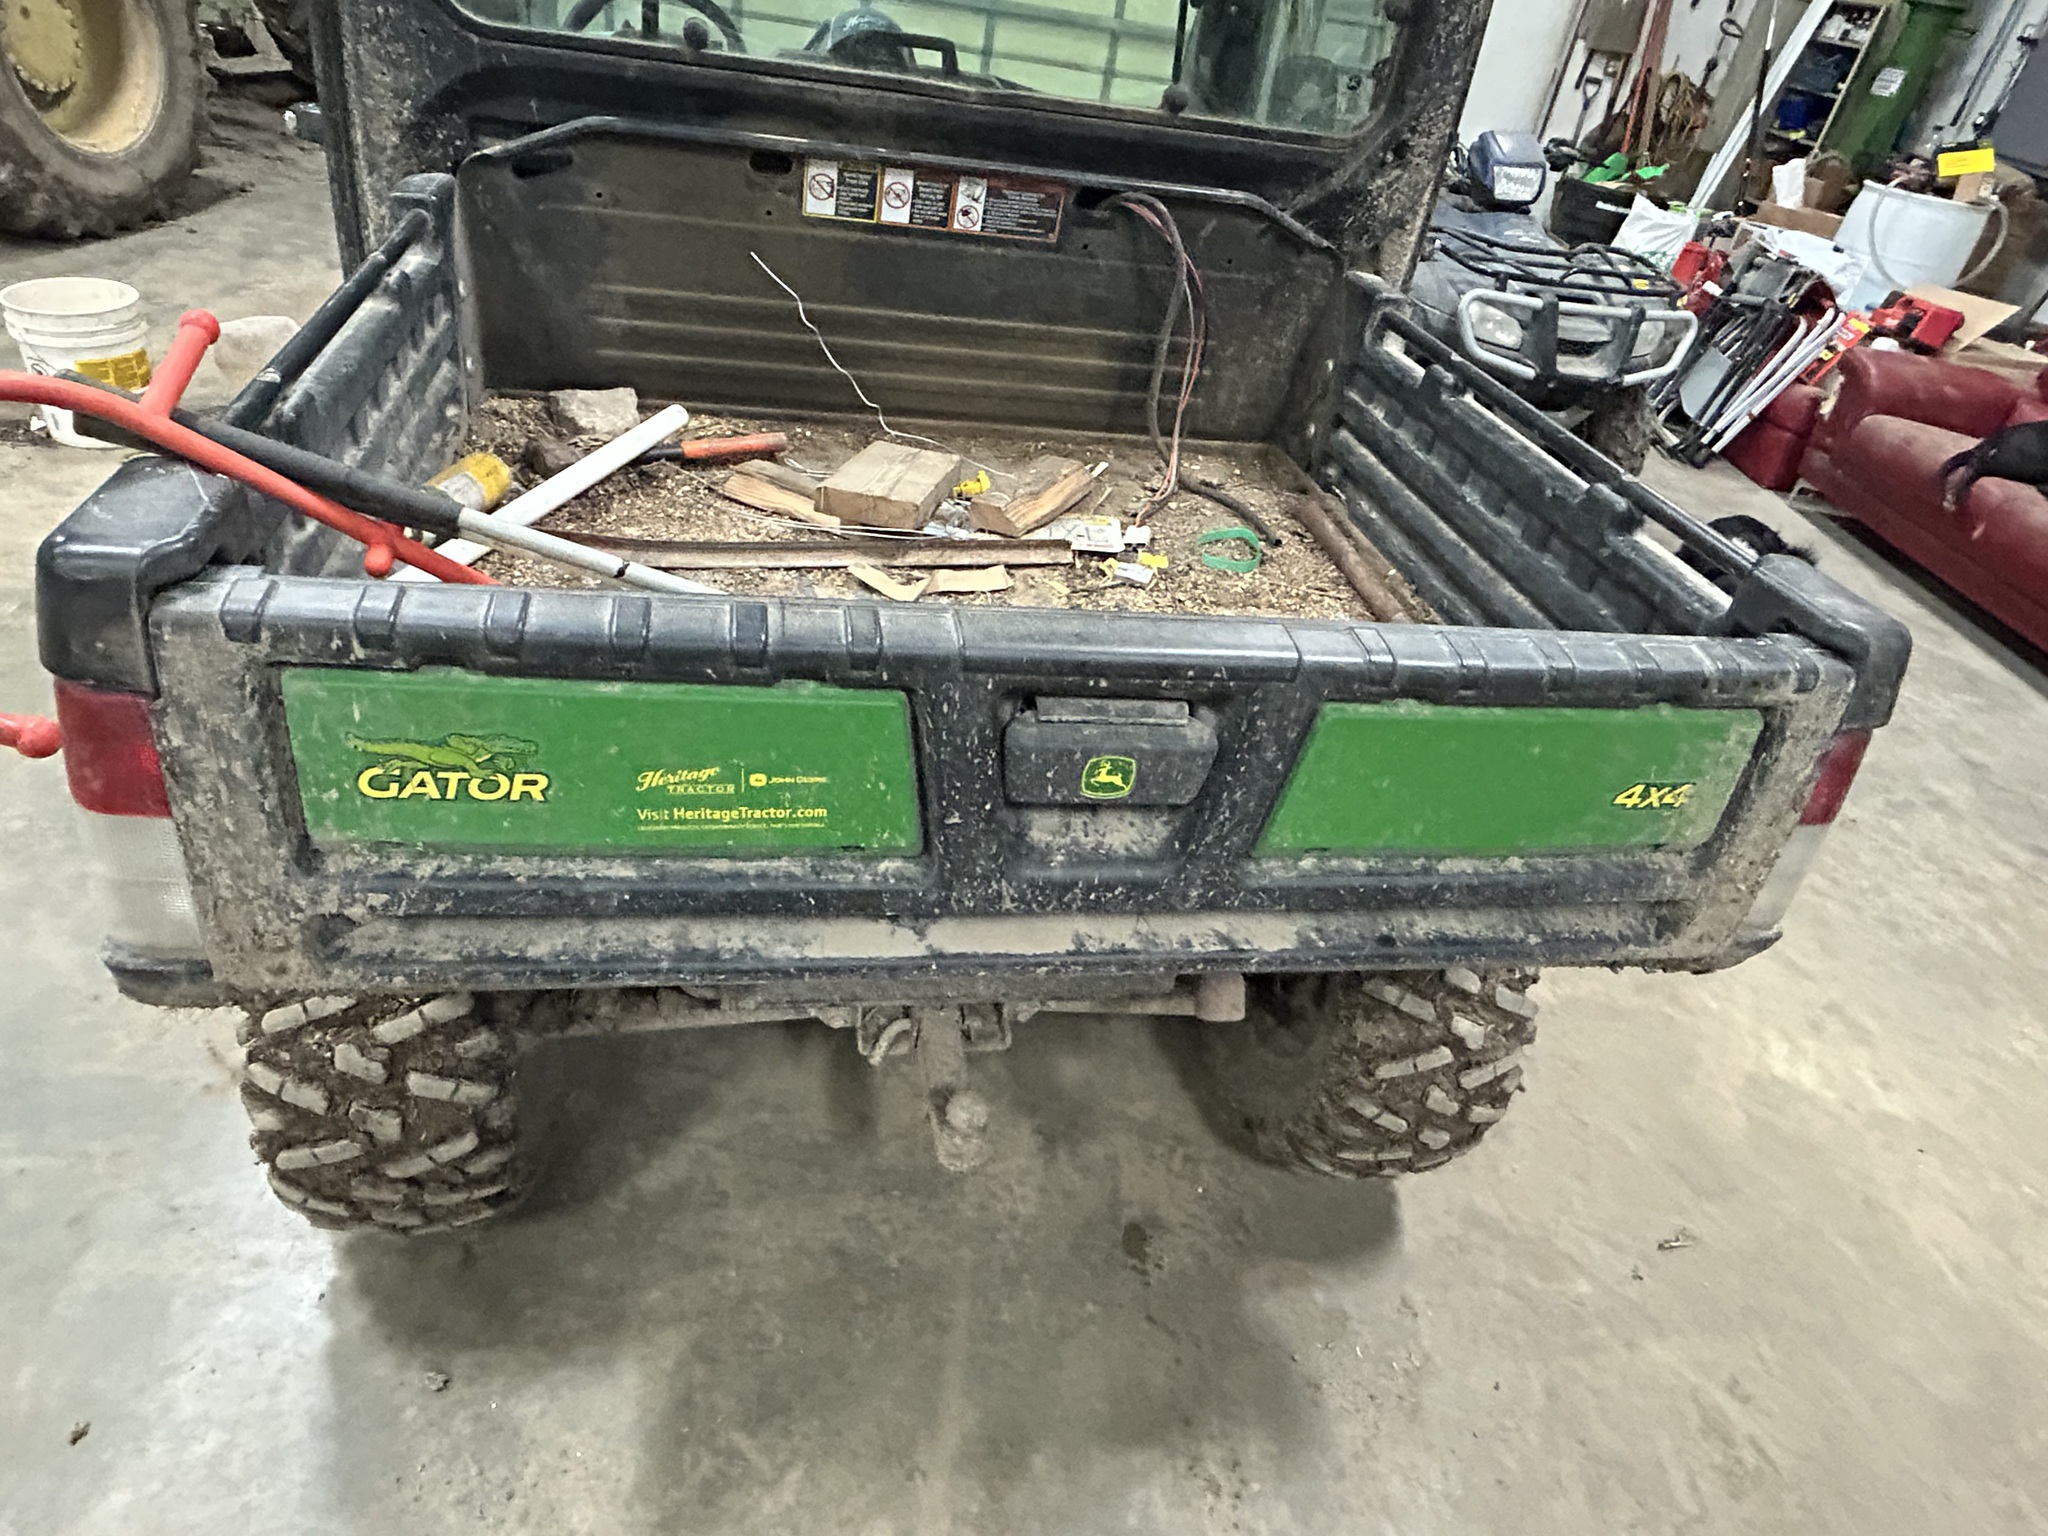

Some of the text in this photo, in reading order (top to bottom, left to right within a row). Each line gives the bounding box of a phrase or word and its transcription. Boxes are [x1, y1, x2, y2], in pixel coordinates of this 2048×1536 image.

[357, 766, 549, 802] GATOR
[635, 766, 720, 792] Heritage
[667, 784, 735, 795] TRACTOR
[636, 806, 828, 822] Visit HeritageTractor.com
